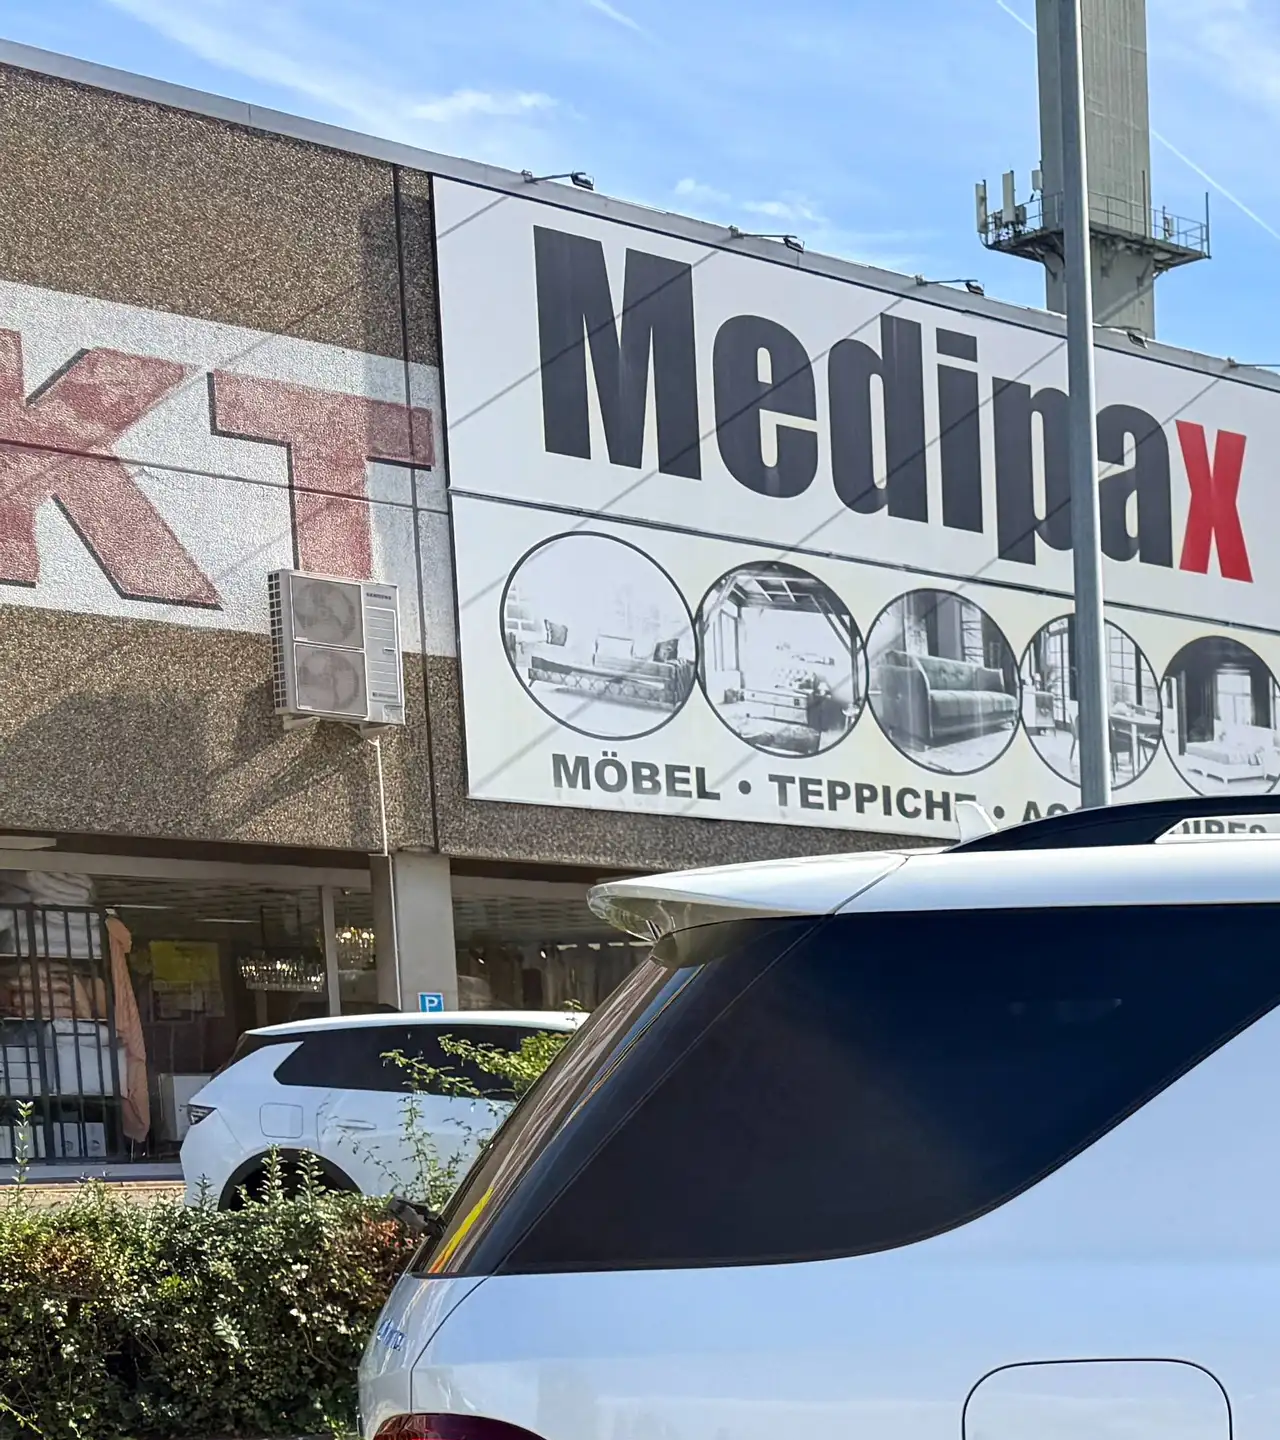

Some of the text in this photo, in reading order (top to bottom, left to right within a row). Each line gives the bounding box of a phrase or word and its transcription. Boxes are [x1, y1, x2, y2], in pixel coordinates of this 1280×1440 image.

[533, 224, 1254, 583] Medipax
[551, 751, 721, 801] MÖBEL
[768, 774, 977, 822] TEPPICH
[425, 996, 438, 1012] P
